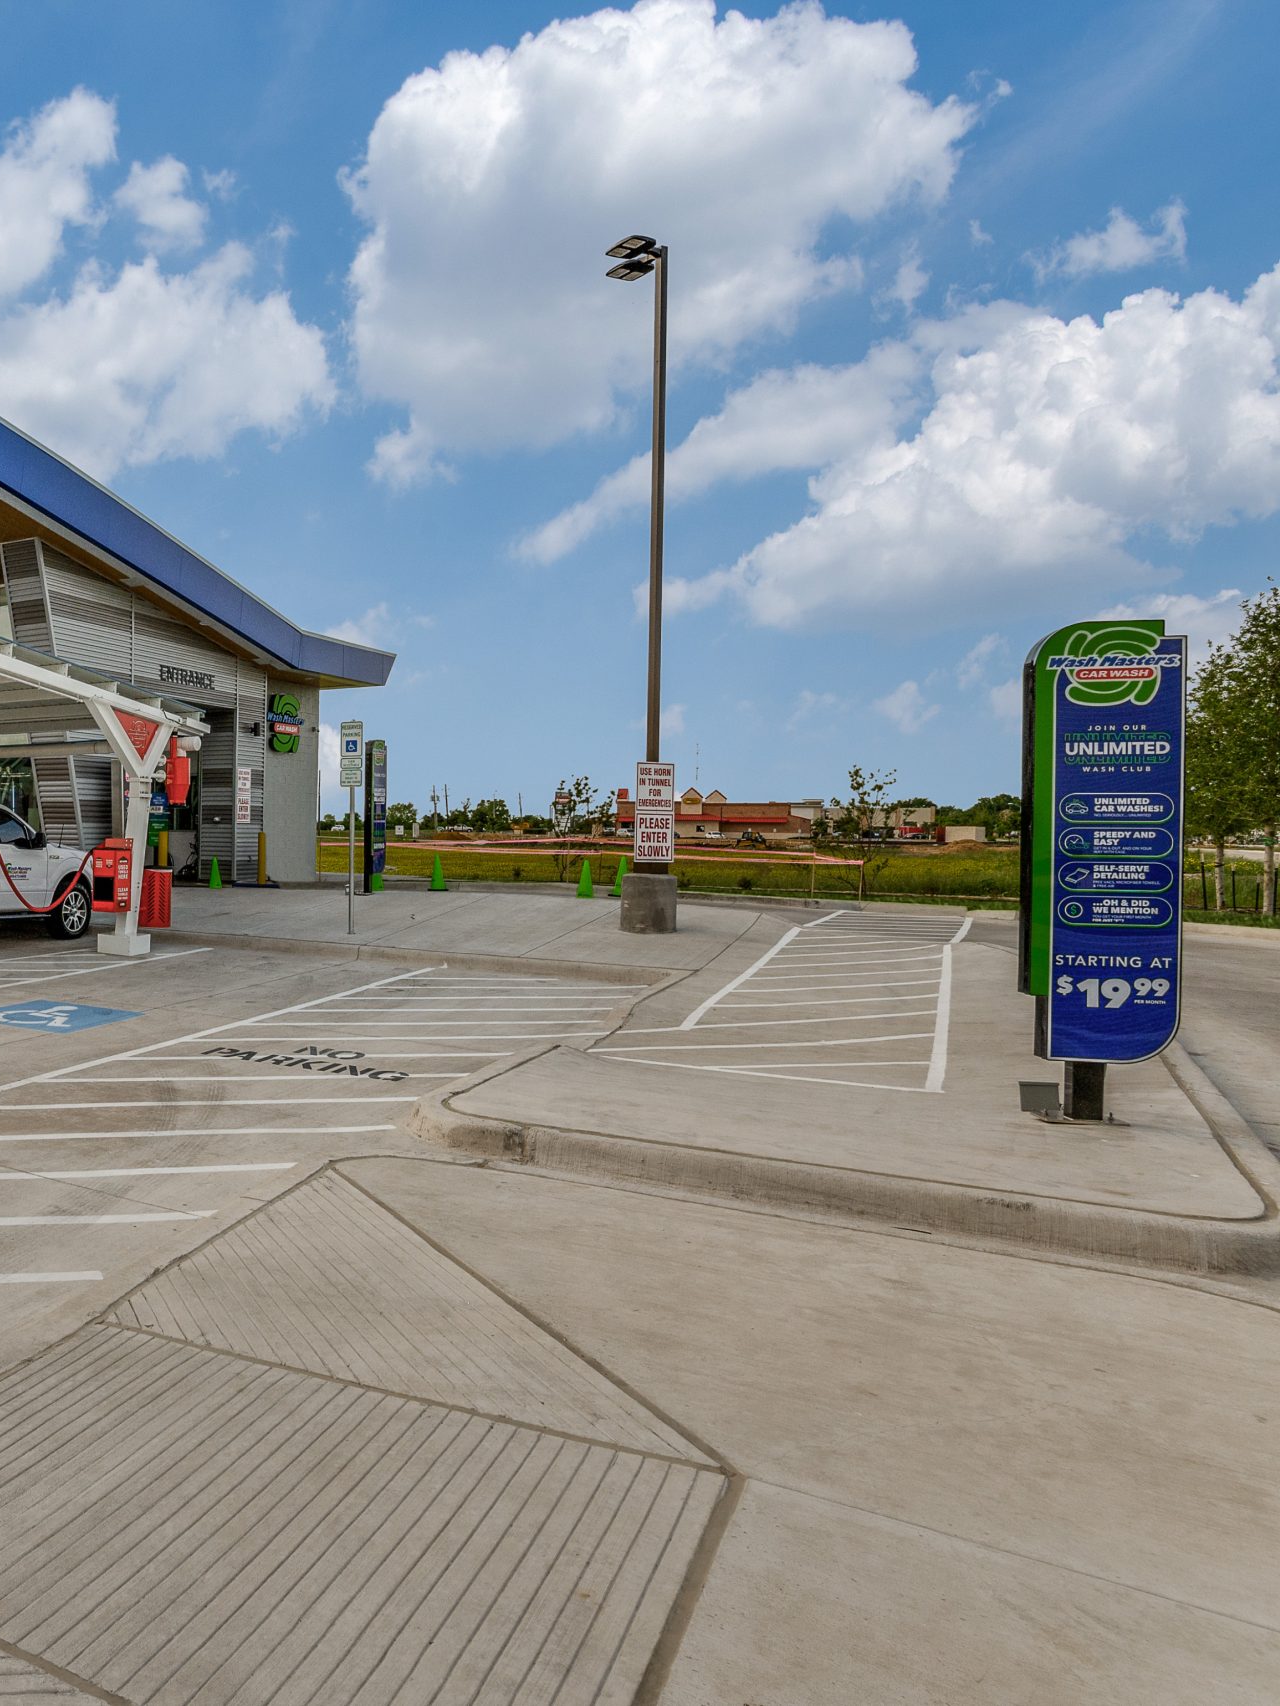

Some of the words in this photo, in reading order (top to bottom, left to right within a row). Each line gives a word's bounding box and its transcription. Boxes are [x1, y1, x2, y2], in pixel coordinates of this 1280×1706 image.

[1048, 655, 1097, 668] Wash
[1100, 655, 1179, 667] Masters
[160, 664, 215, 690] ENTRANCE
[1080, 669, 1107, 678] CAR
[1111, 669, 1149, 678] WASH
[267, 711, 283, 722] Wash
[1065, 741, 1171, 755] UNLIMITED
[640, 767, 652, 776] USE
[654, 768, 671, 776] HORN
[639, 778, 646, 786] IN
[648, 778, 671, 787] TUNNEL
[648, 789, 661, 797] FOR
[638, 799, 671, 808] EMERGENCIES
[639, 817, 670, 829] PLEASE
[641, 831, 667, 843] ENTER
[1093, 838, 1119, 846] EASY
[638, 845, 670, 857] SLOWLY
[1055, 954, 1142, 968] STARTING
[1150, 957, 1172, 968] AT
[294, 1045, 366, 1060] NO
[201, 1047, 410, 1081] PARKING
